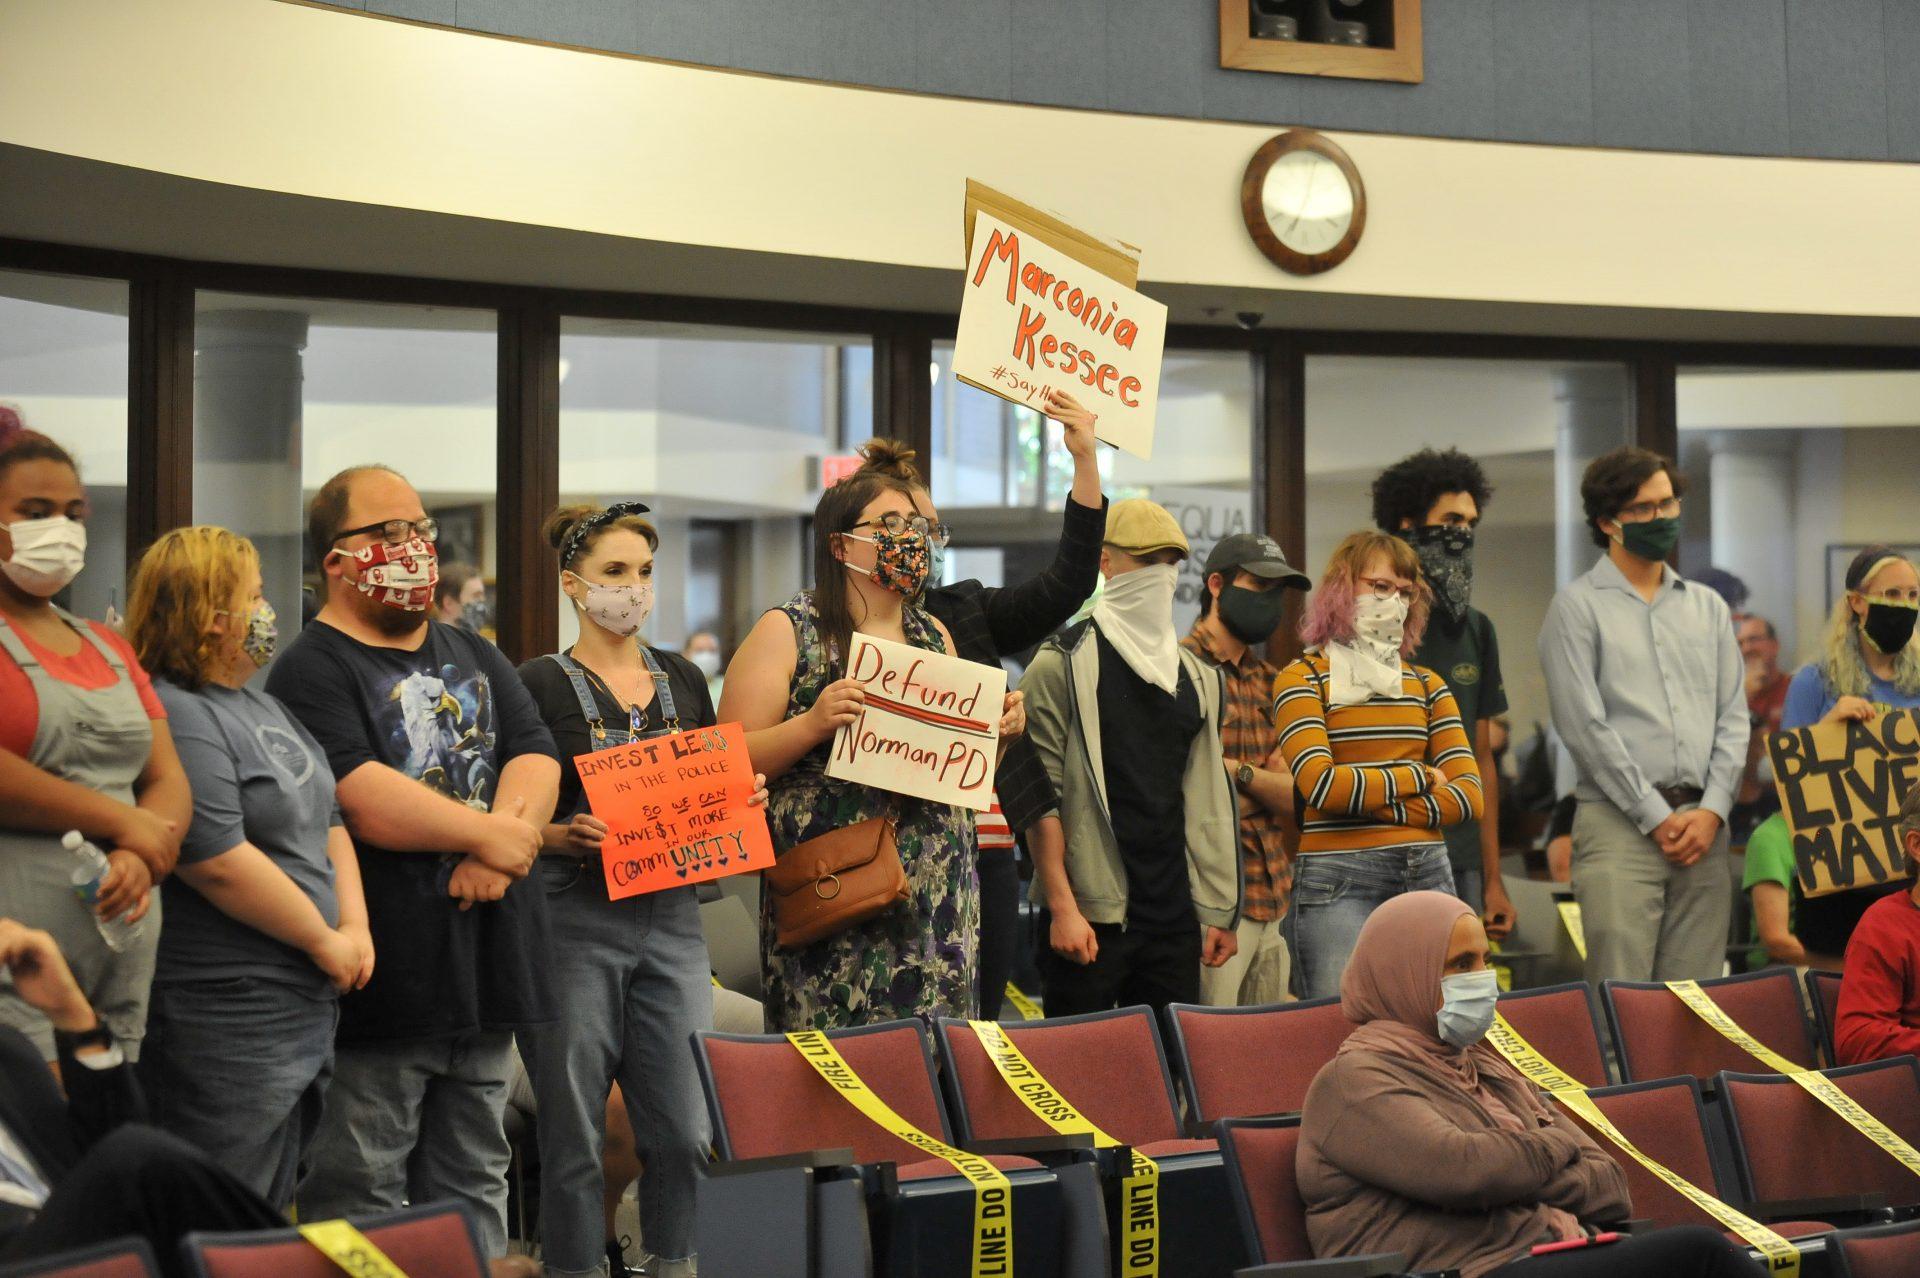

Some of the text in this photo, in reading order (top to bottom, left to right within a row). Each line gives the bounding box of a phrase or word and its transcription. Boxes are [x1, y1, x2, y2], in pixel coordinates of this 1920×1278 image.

[972, 228, 1139, 351] Marconia
[1012, 303, 1142, 408] Kessee
[852, 642, 982, 717] Defund
[578, 744, 659, 777] INVEST
[614, 759, 729, 793] IN THE POLICE
[699, 787, 727, 804] CAN
[665, 829, 712, 849] IN OUR
[814, 1060, 861, 1090] FIRE
[996, 1053, 1036, 1079] NOT
[1018, 1082, 1077, 1122] CROSS
[953, 1155, 999, 1182] NOT
[981, 1188, 1006, 1219] DO
[1130, 1183, 1155, 1233] LINE
[979, 1226, 1007, 1275] LINE
[1129, 1237, 1155, 1268] DO
